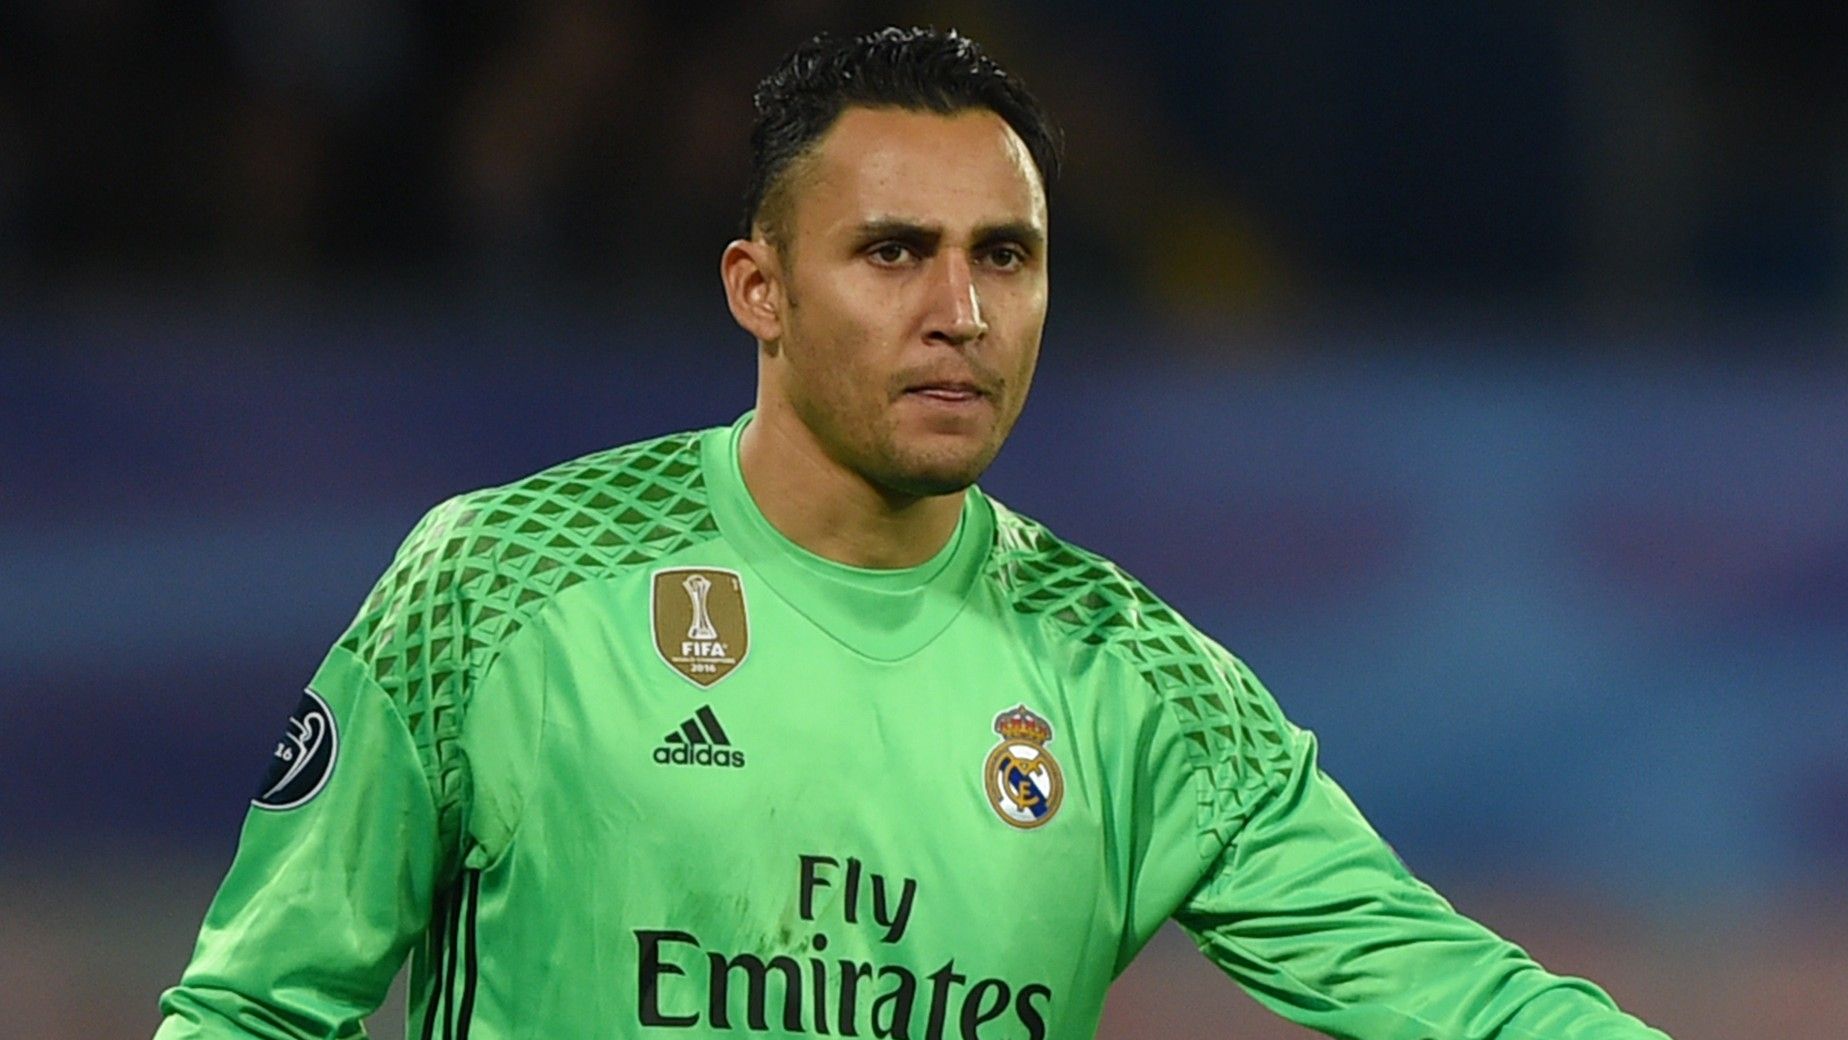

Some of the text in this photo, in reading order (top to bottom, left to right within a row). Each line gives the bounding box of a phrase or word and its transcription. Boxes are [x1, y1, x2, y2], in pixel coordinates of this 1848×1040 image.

[681, 641, 726, 657] FIFA
[653, 742, 746, 768] adidas
[798, 854, 917, 943] Fly
